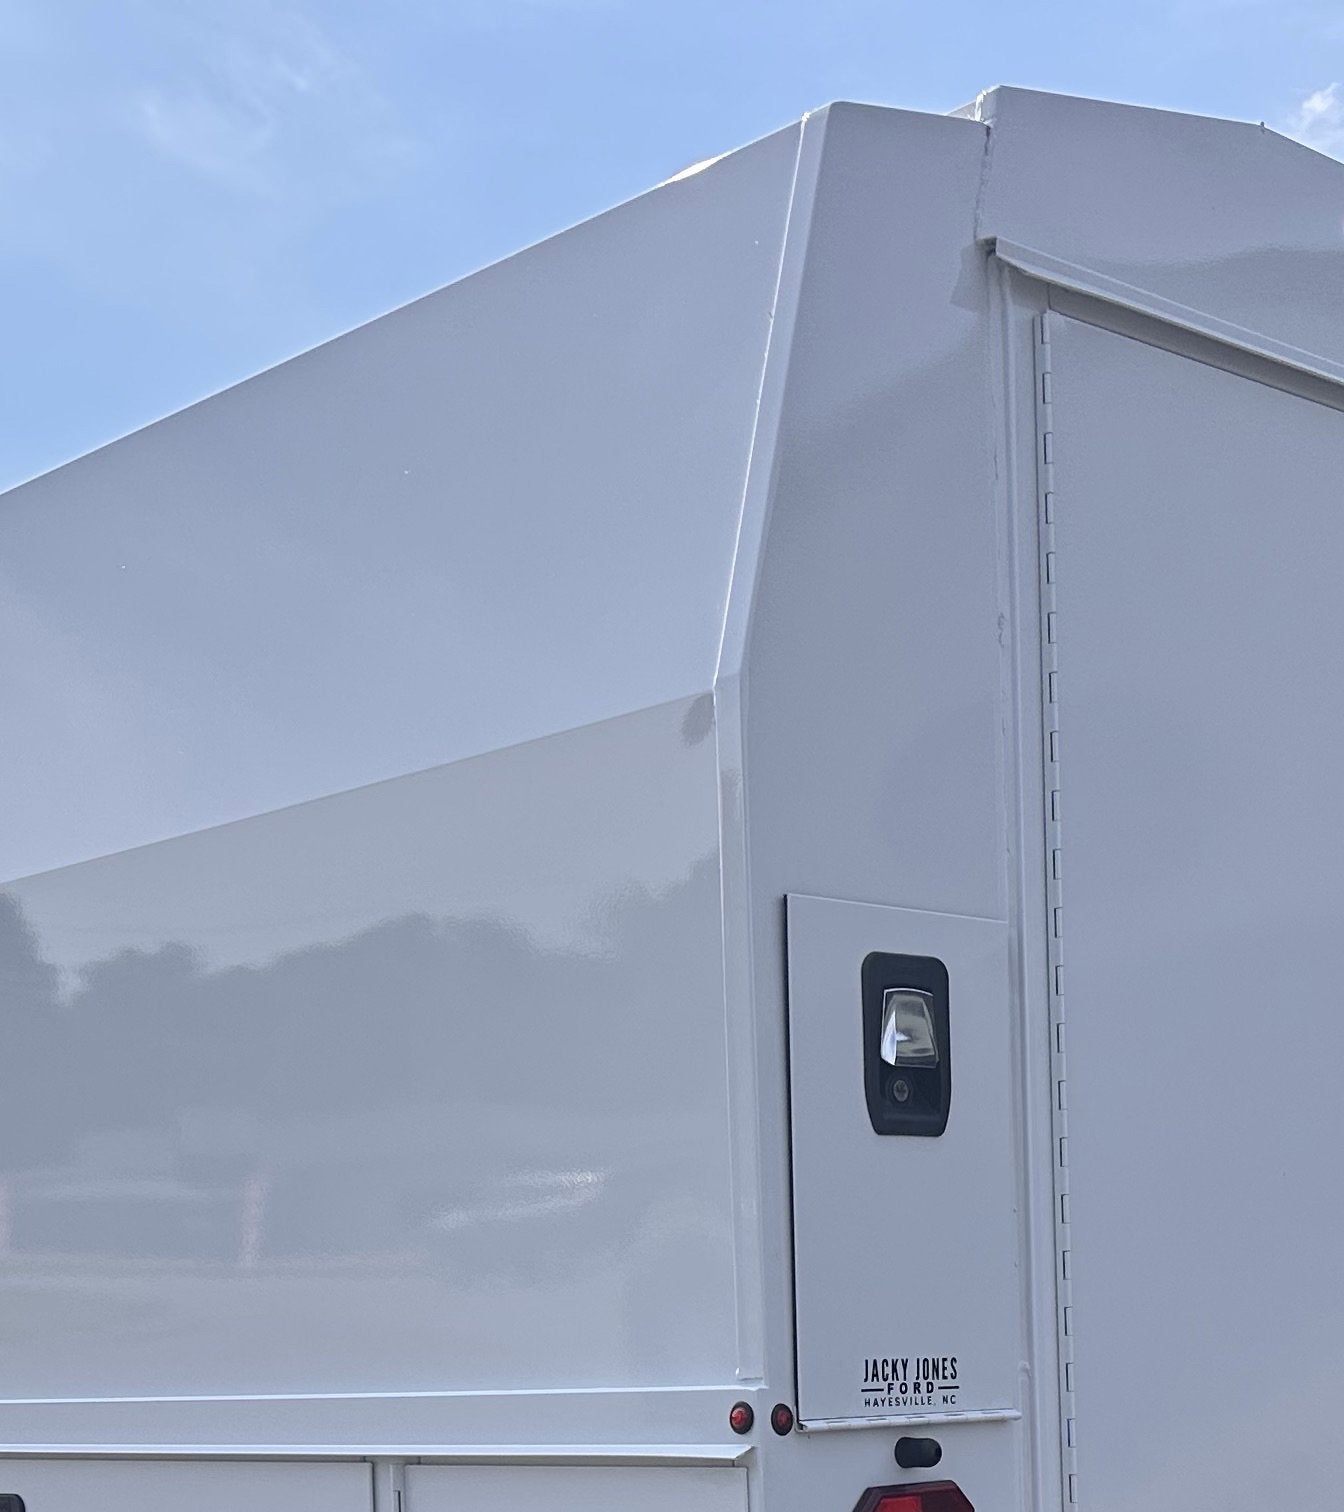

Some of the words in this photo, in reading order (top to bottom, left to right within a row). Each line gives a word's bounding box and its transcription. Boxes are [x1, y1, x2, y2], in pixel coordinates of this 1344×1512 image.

[863, 1358, 909, 1382] JACKY
[915, 1357, 958, 1381] JONES
[887, 1381, 935, 1395] FORD
[864, 1395, 937, 1408] HAYESVILLE,
[942, 1394, 957, 1405] NC
